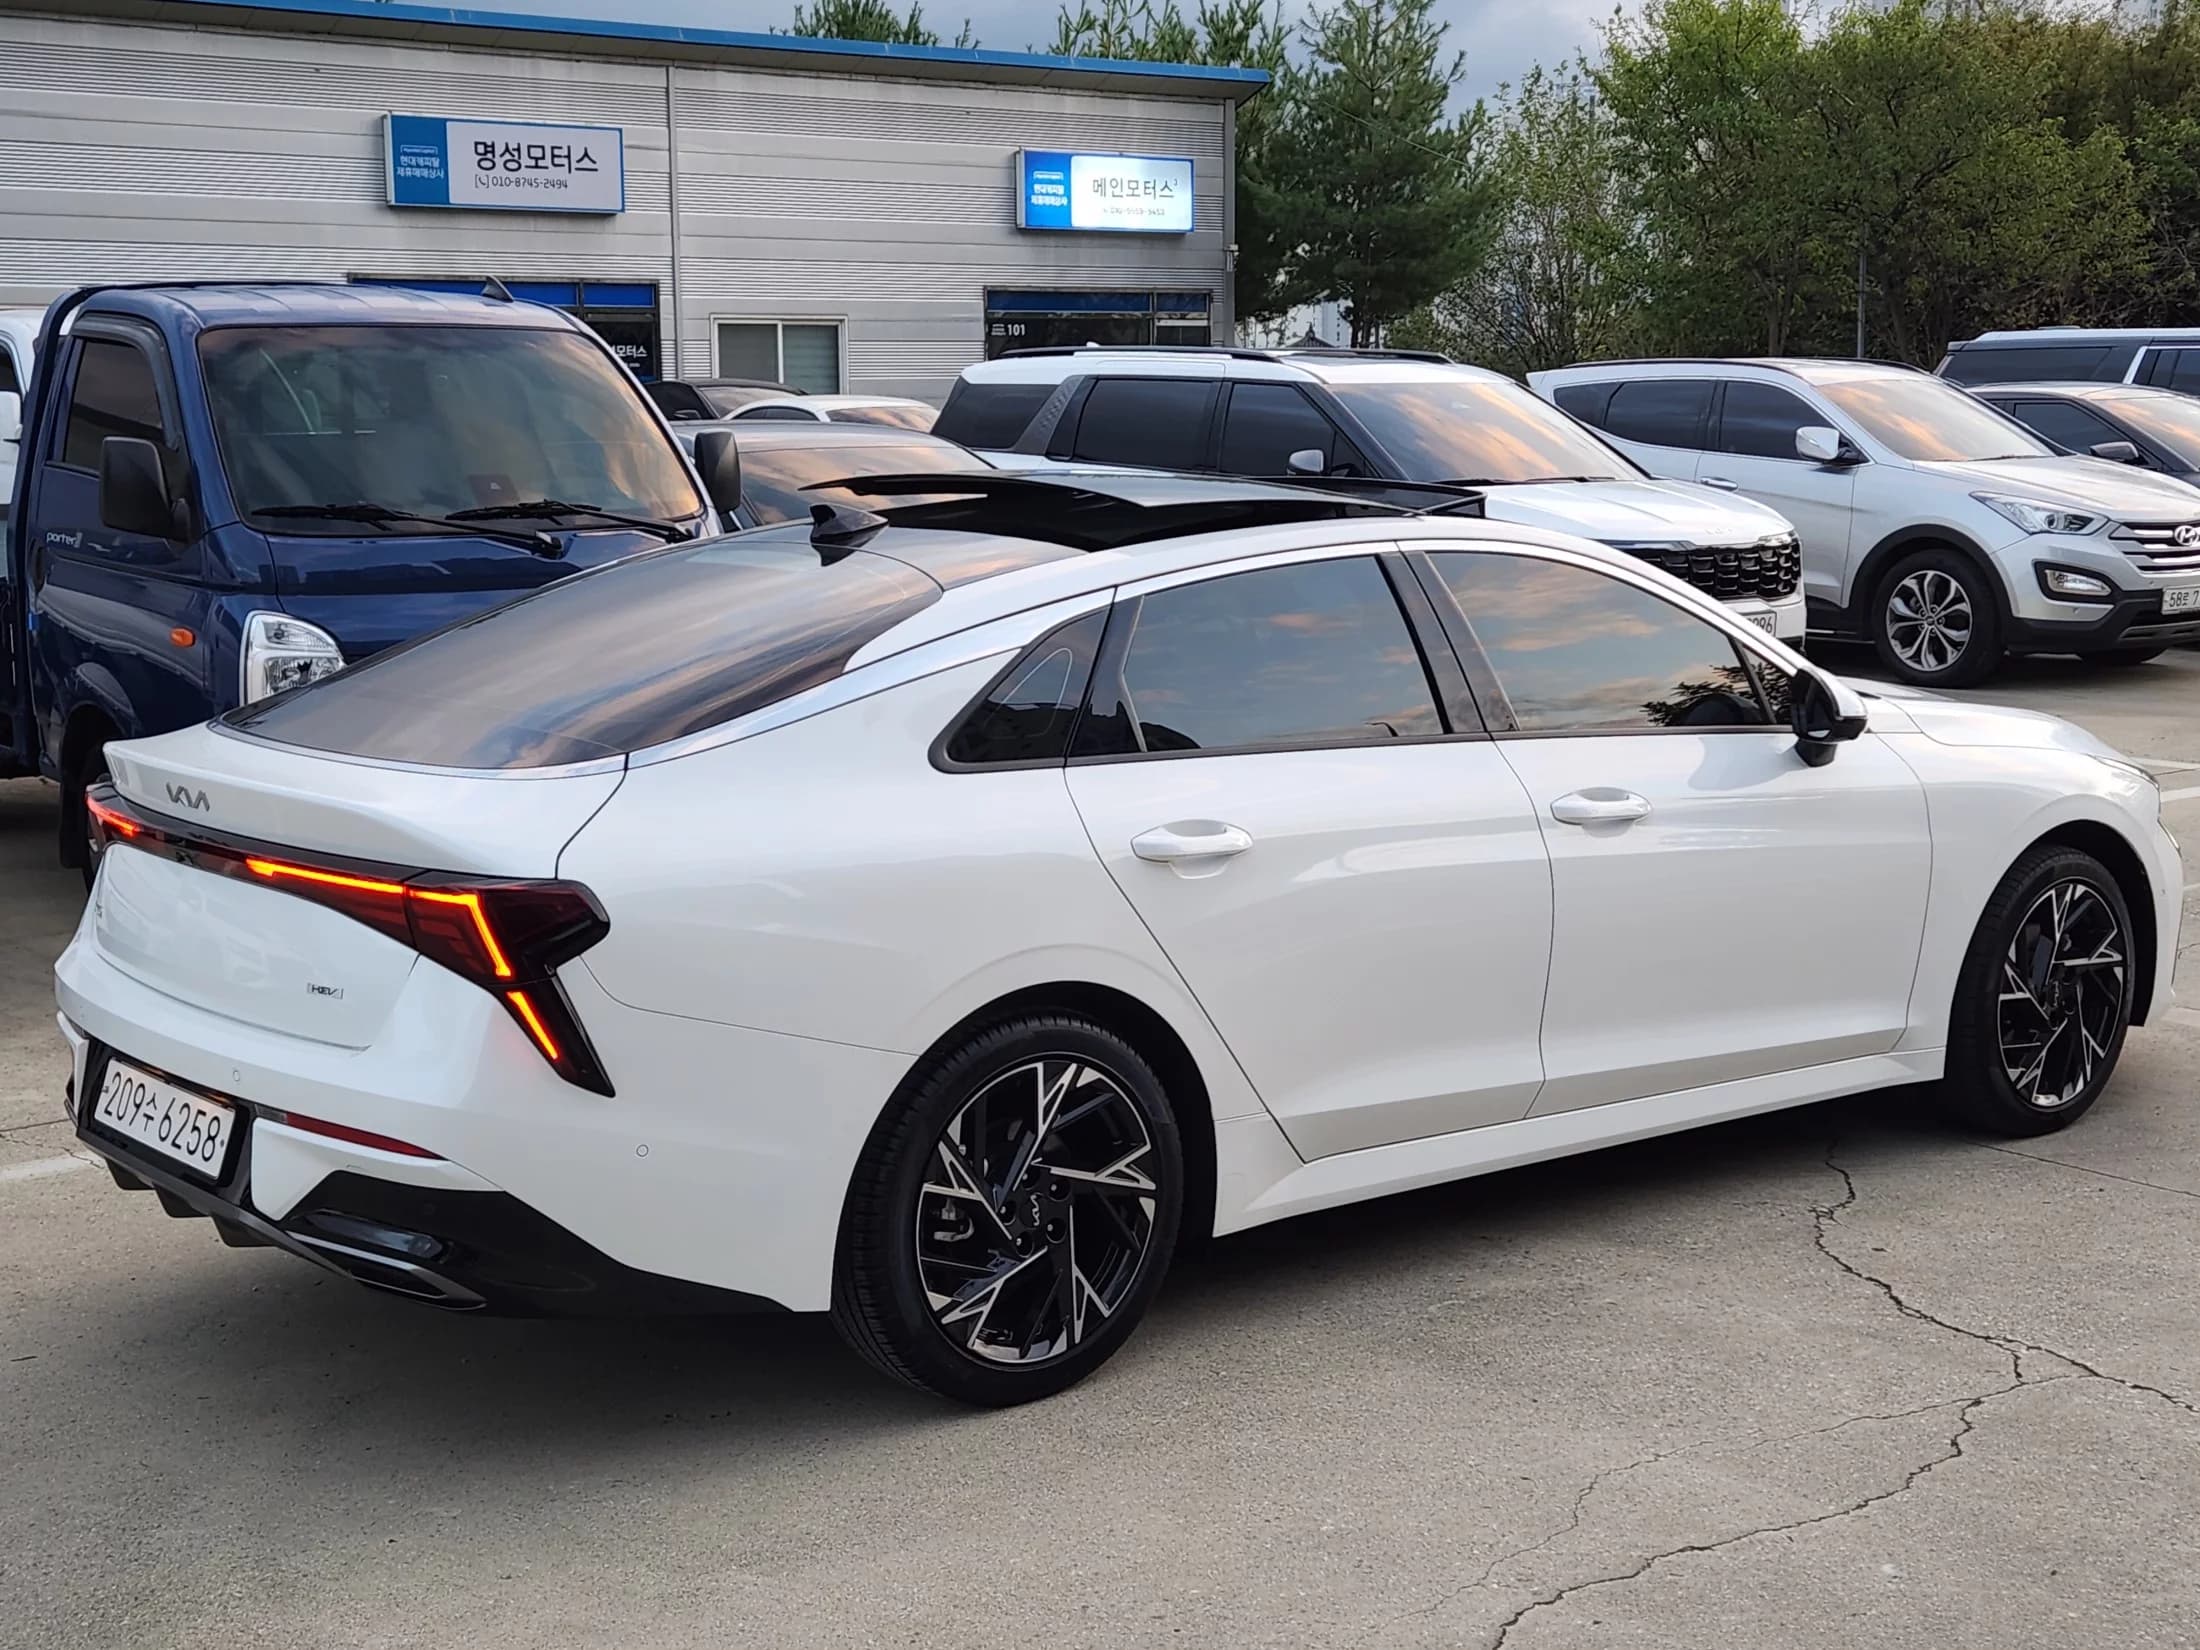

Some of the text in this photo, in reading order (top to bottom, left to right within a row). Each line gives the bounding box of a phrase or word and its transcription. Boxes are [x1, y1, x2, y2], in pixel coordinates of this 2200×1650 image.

[474, 140, 599, 174] 명성모터스
[491, 175, 568, 189] 010-8745-2494
[1092, 177, 1175, 200] 메인모터스
[1007, 323, 1026, 336] 101
